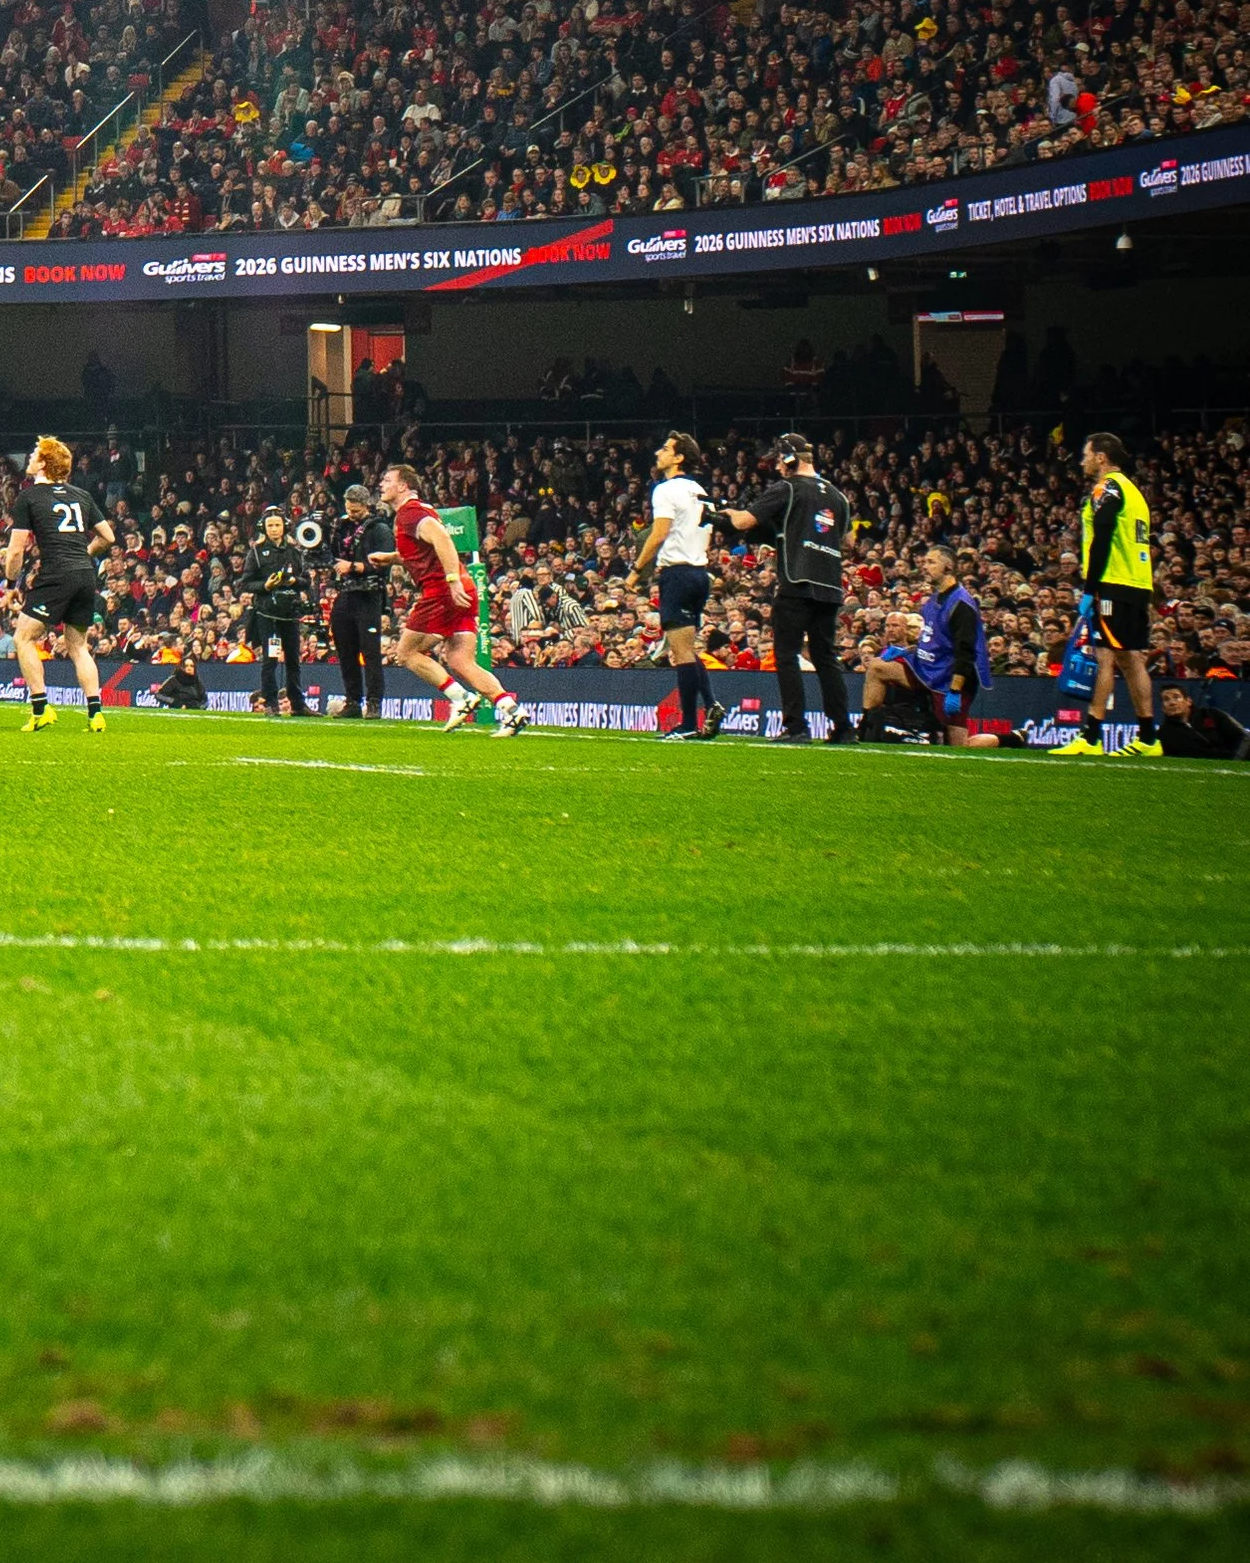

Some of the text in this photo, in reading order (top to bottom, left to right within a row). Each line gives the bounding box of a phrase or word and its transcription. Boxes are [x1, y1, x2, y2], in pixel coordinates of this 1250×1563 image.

[694, 234, 723, 253] 2026
[726, 229, 784, 251] GUINNESS
[786, 225, 817, 245] MEN'S
[818, 223, 835, 242] SIX
[836, 219, 880, 240] NATIONS
[23, 265, 77, 284] BOOK
[80, 263, 127, 282] NOW
[235, 257, 278, 275] 2026
[281, 254, 366, 273] GUINNESS
[369, 252, 420, 270] MEN'S
[423, 250, 451, 268] SIX
[454, 247, 522, 267] NATIONS
[52, 502, 85, 533] 21
[536, 702, 578, 727] GUINNESS
[622, 705, 658, 731] NATIONS
[765, 710, 786, 738] 202
